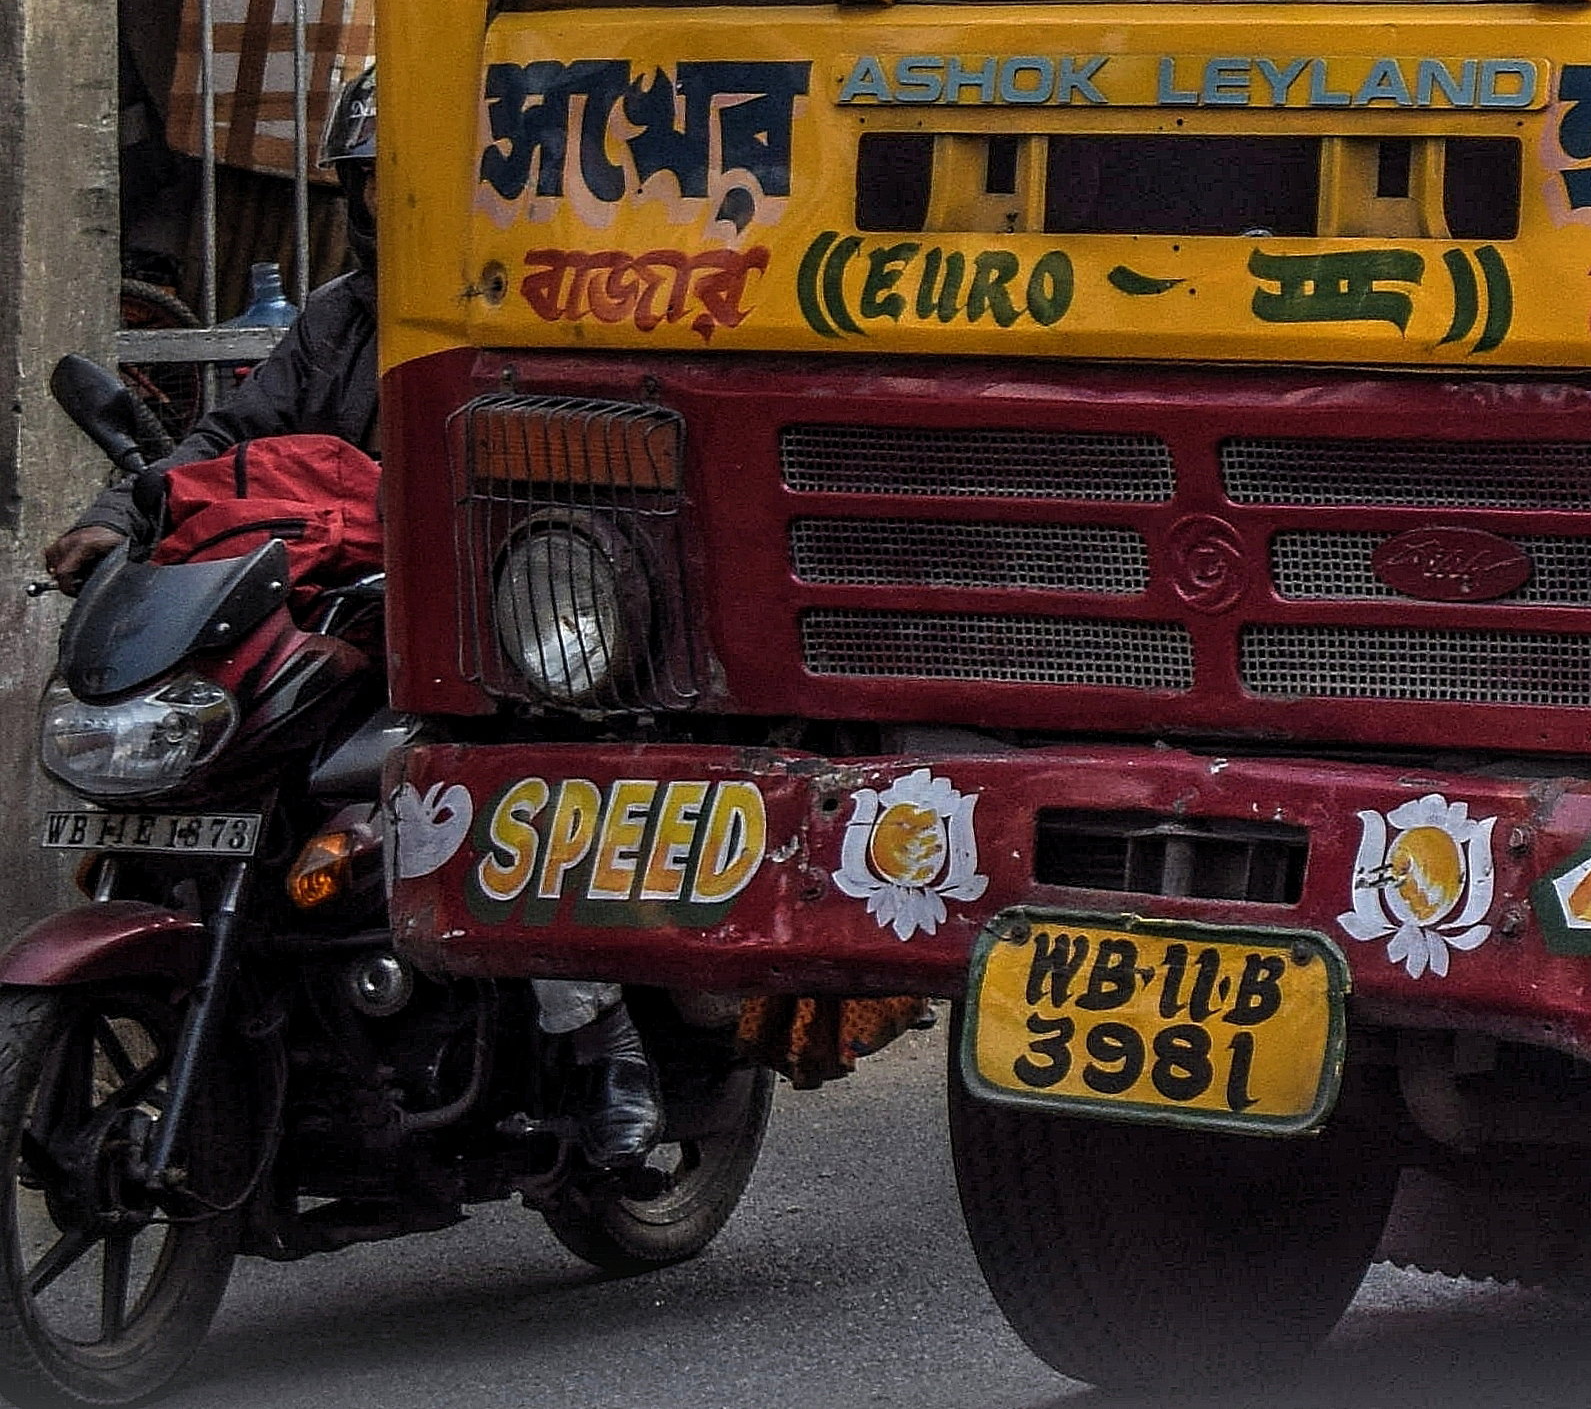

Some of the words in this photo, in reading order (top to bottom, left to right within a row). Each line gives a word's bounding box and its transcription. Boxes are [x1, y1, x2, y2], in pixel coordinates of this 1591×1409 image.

[839, 56, 1109, 105] ASHOK
[1157, 56, 1536, 108] LEYLAND
[520, 246, 771, 342] বাজার
[478, 776, 768, 904] SPEED
[1012, 1015, 1262, 1112] 3981
